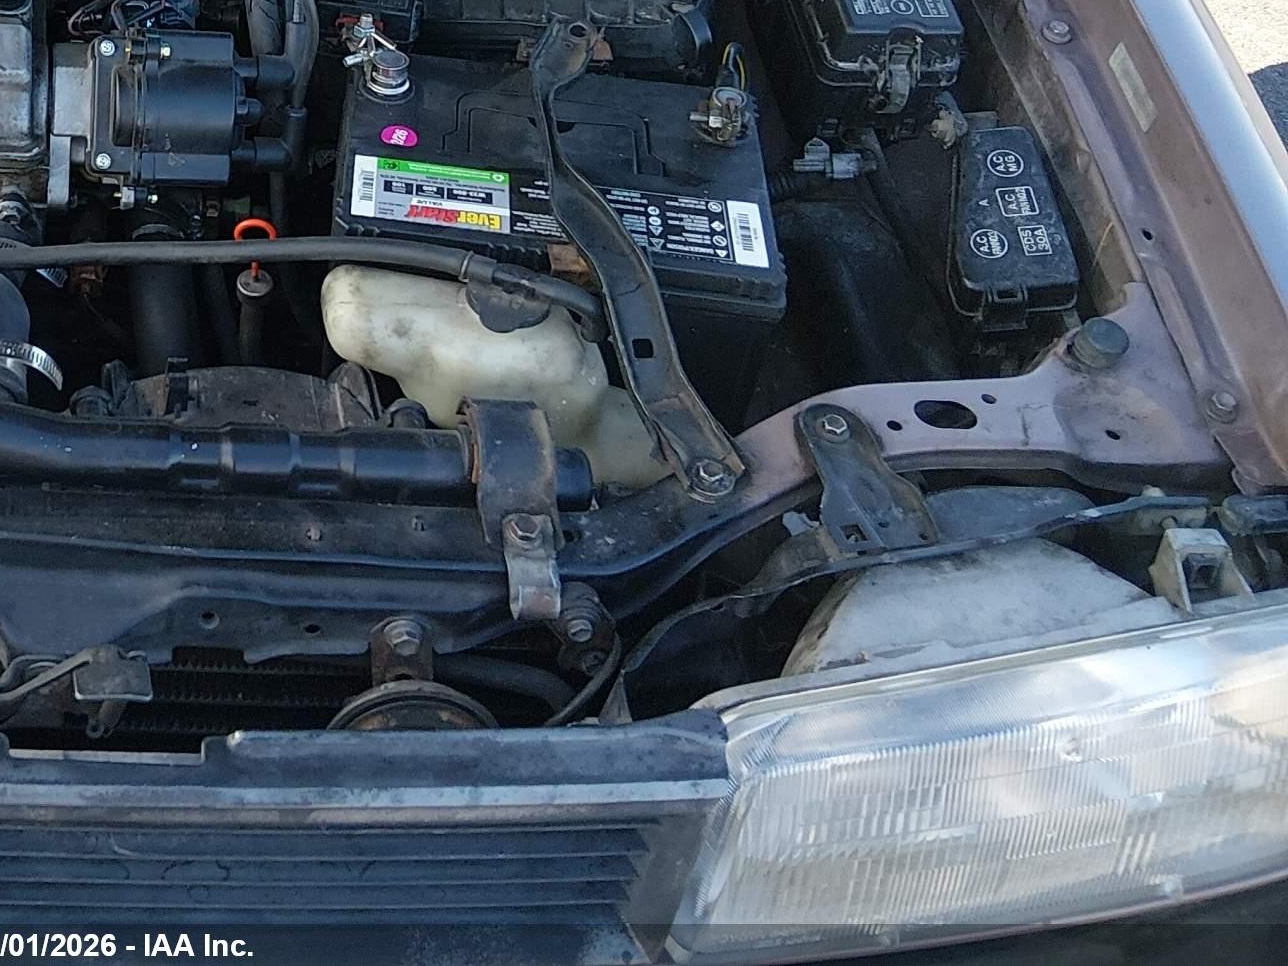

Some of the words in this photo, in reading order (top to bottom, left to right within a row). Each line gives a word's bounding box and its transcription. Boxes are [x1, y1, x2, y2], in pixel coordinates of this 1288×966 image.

[978, 198, 990, 207] A
[404, 204, 502, 230] EverStart
[1021, 229, 1037, 252] CDS
[1033, 228, 1049, 251] 30A
